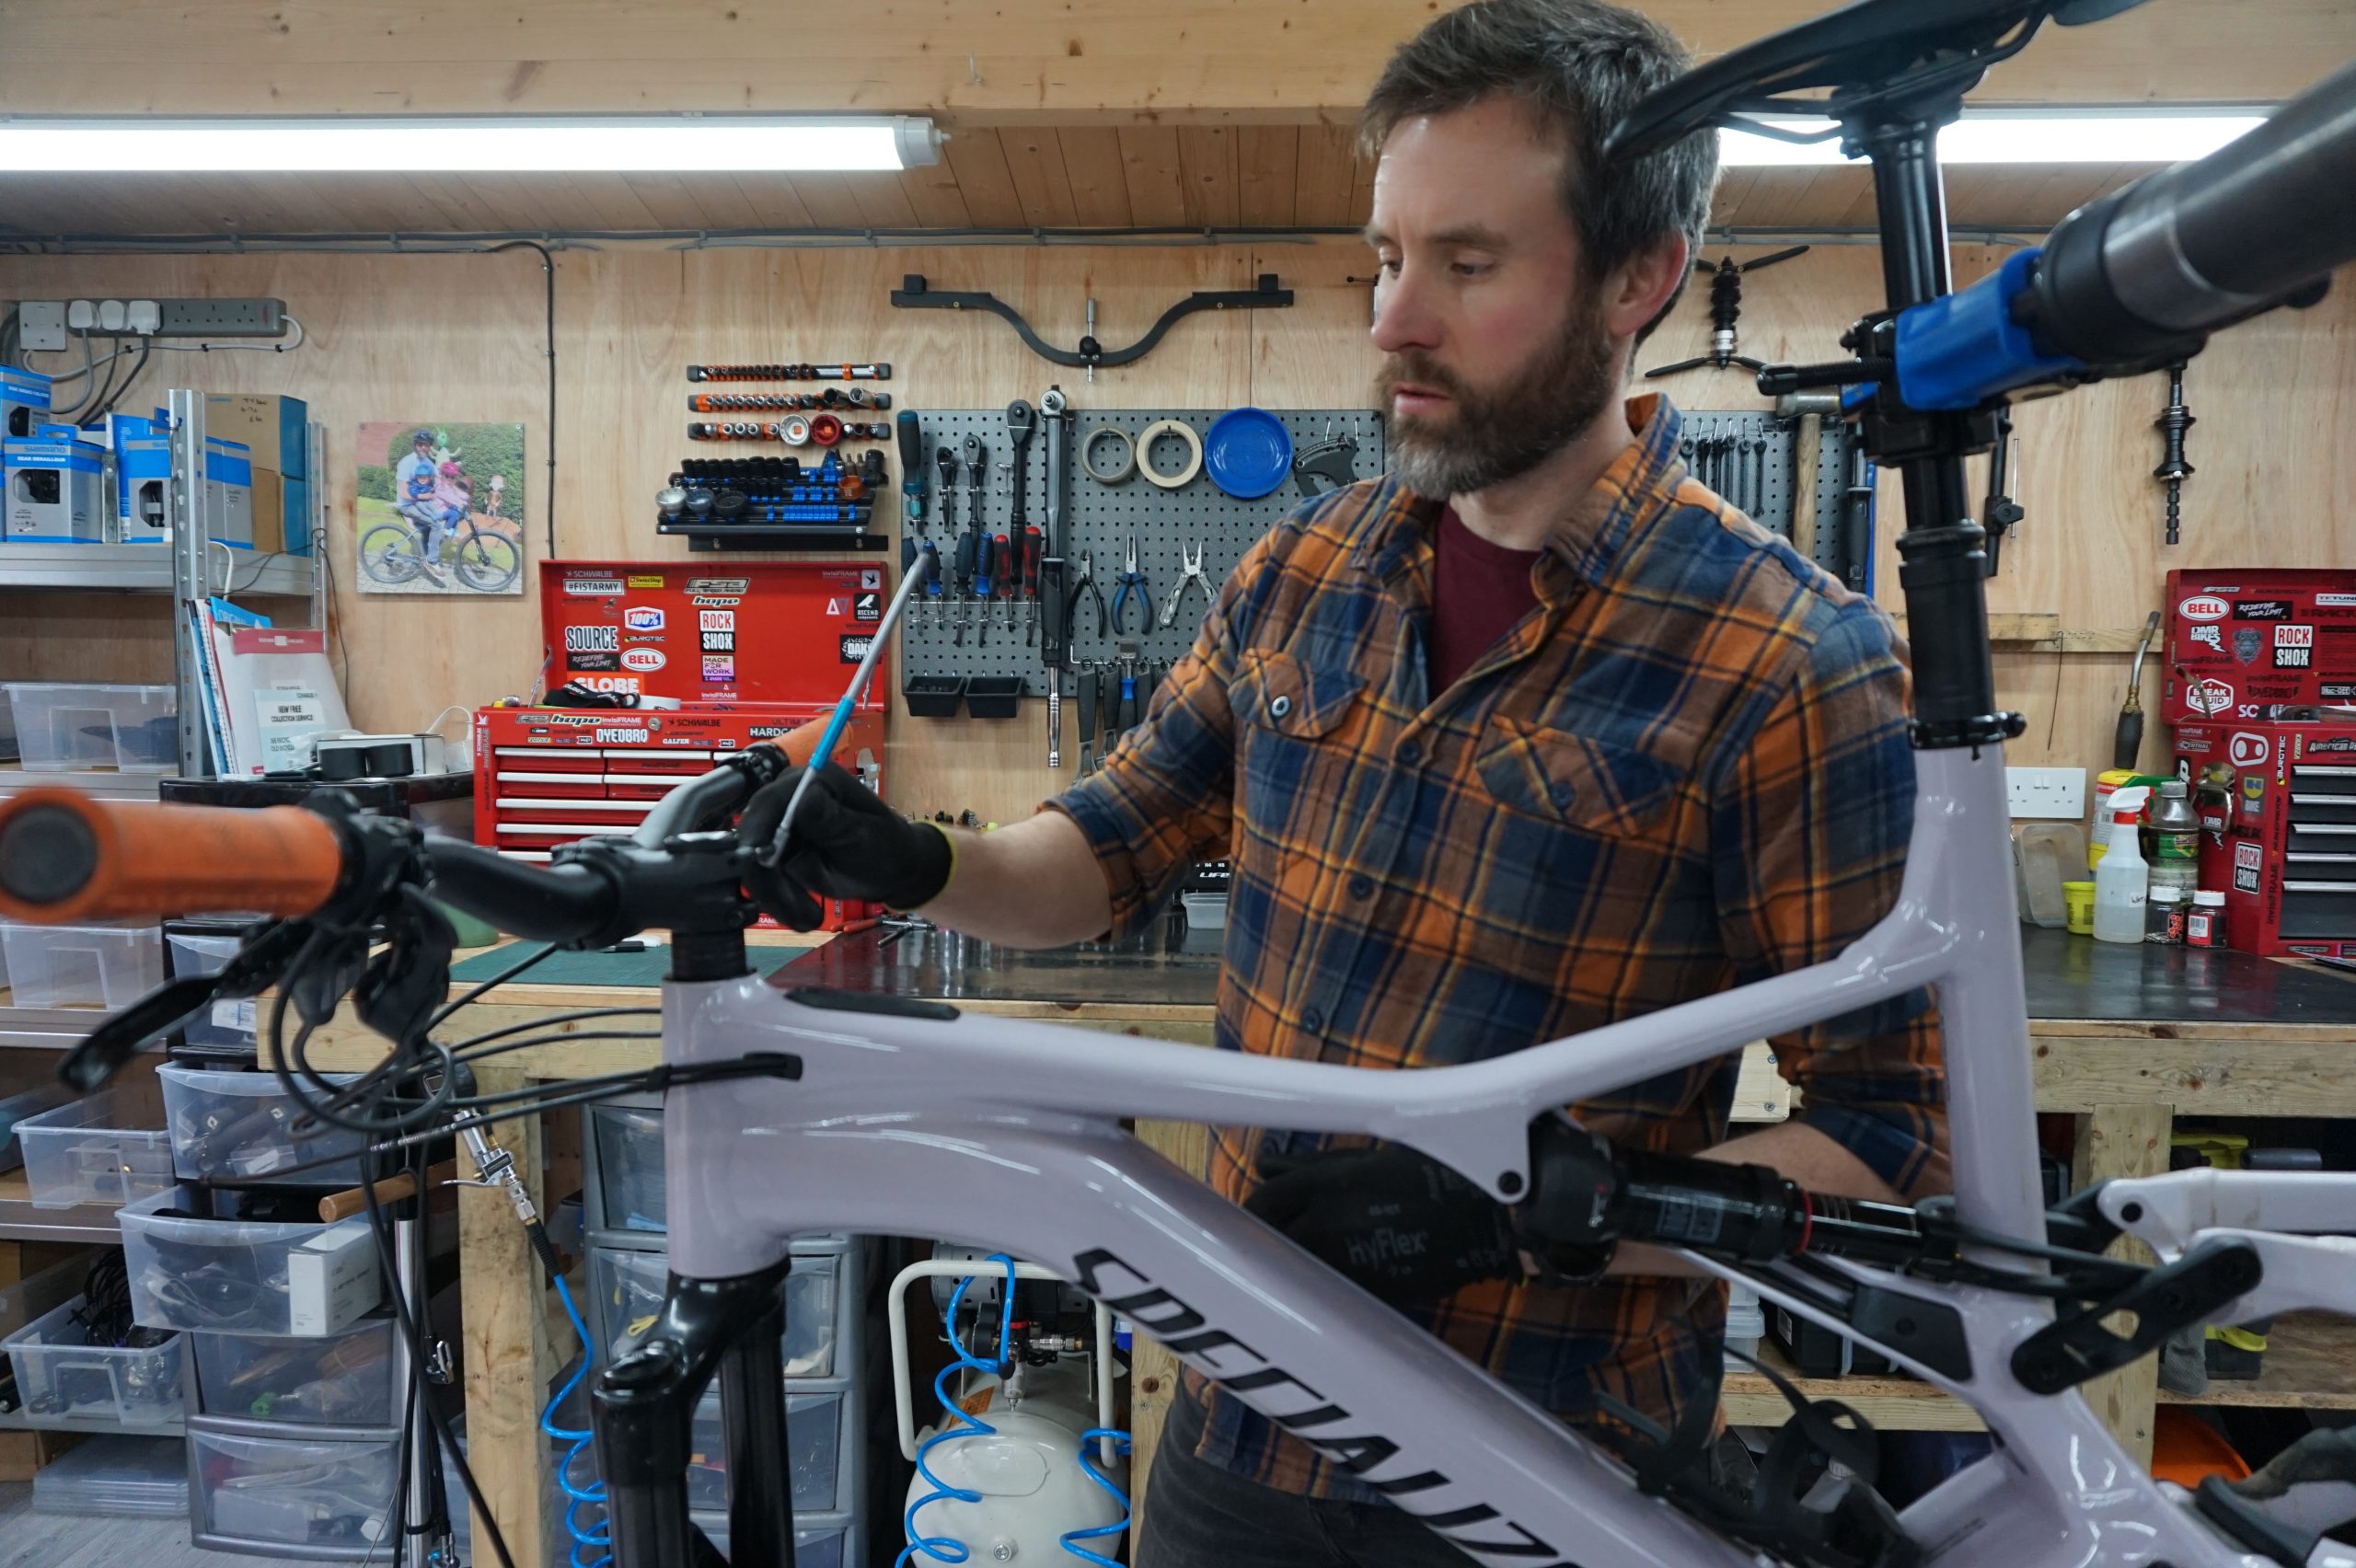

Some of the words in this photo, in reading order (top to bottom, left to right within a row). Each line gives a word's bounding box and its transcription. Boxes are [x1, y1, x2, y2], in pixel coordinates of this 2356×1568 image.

[573, 570, 613, 578] SCHWALBE
[569, 582, 618, 592] #FISTARMY
[694, 596, 739, 606] hope
[2188, 603, 2222, 614] BELL
[629, 613, 659, 626] 100%
[702, 613, 732, 629] ROCK
[566, 626, 618, 651] SOURCE
[702, 632, 733, 651] SHOX
[2278, 628, 2310, 644] ROCK
[628, 654, 659, 664] BELL
[2276, 649, 2309, 666] SHOX
[2193, 688, 2227, 697] BEAK
[551, 714, 601, 726] hope
[676, 719, 722, 727] SCHWALBE
[595, 729, 649, 744] DYEDBRO
[2310, 742, 2348, 753] American
[2238, 847, 2259, 868] ROCK
[2236, 868, 2258, 889] SHOX
